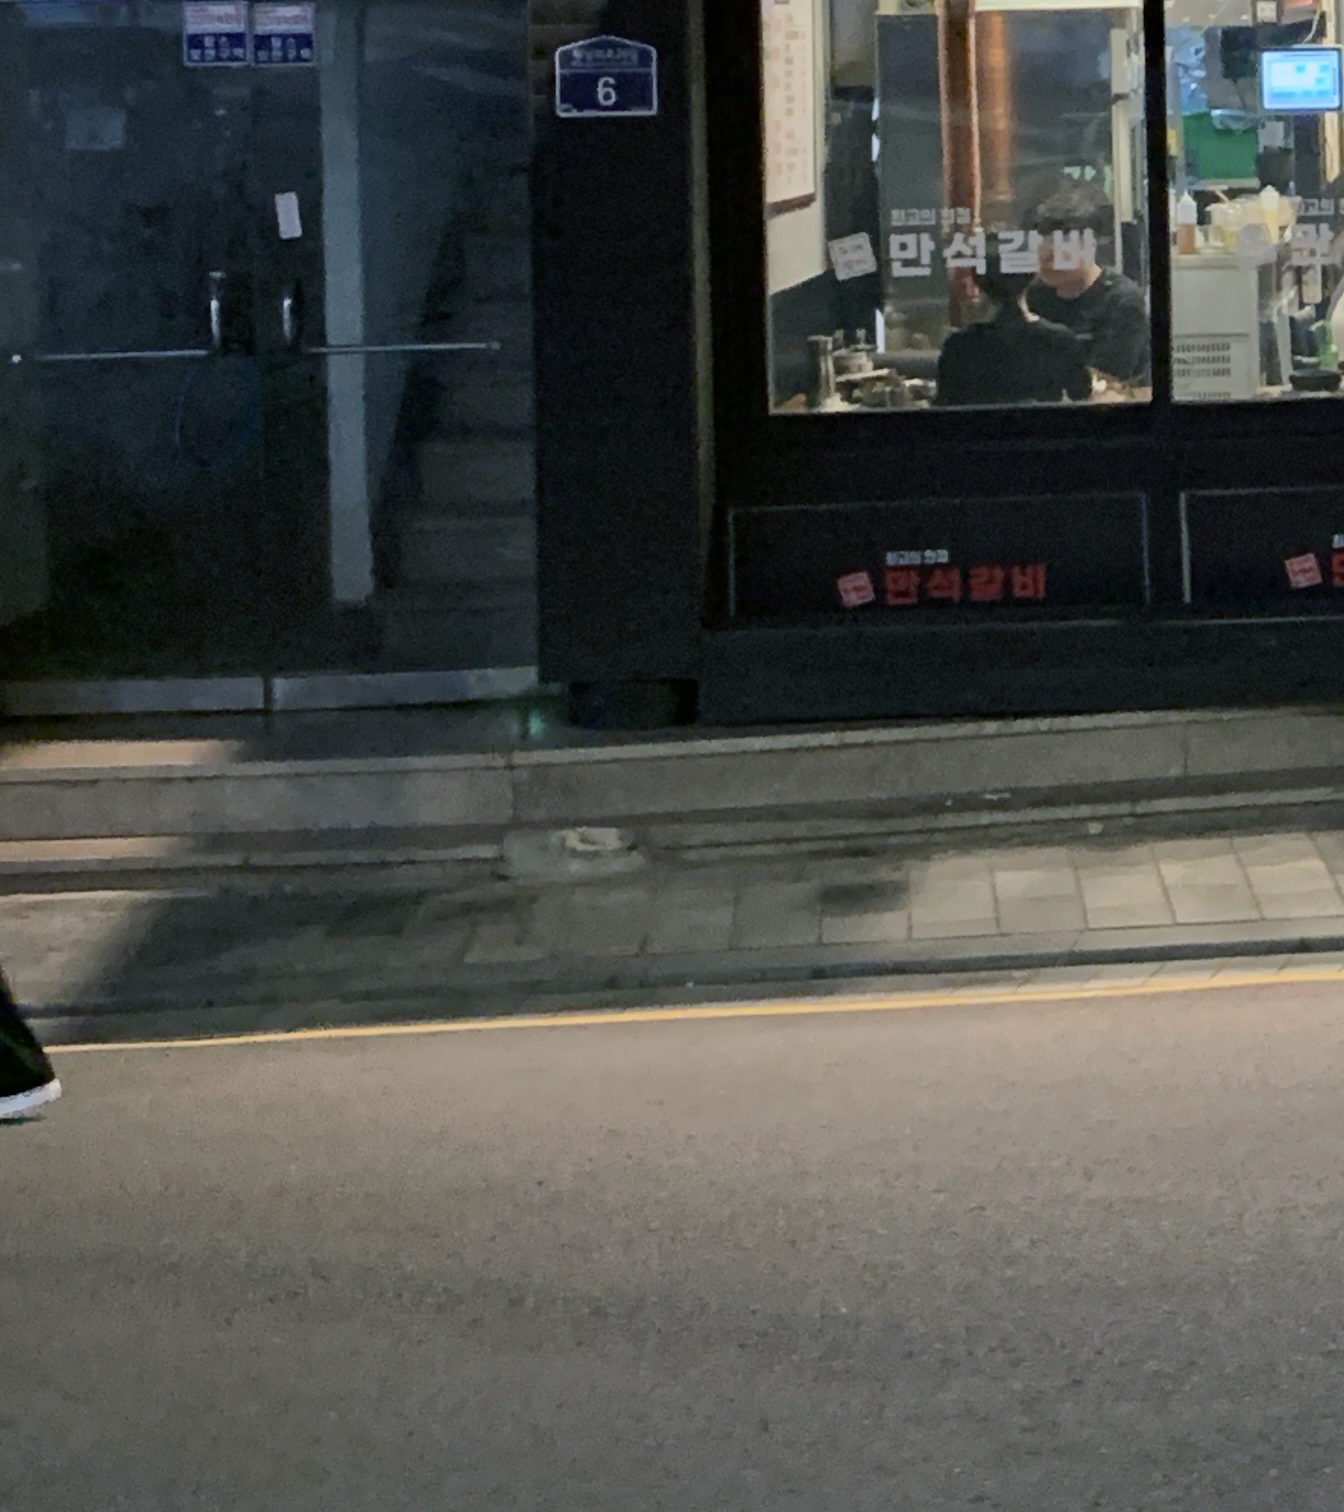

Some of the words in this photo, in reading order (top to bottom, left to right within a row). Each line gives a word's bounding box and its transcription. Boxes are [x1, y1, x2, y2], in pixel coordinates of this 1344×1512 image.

[597, 76, 616, 106] 6
[889, 228, 1099, 278] 만석갈비
[884, 563, 1046, 606] 만석갈비
